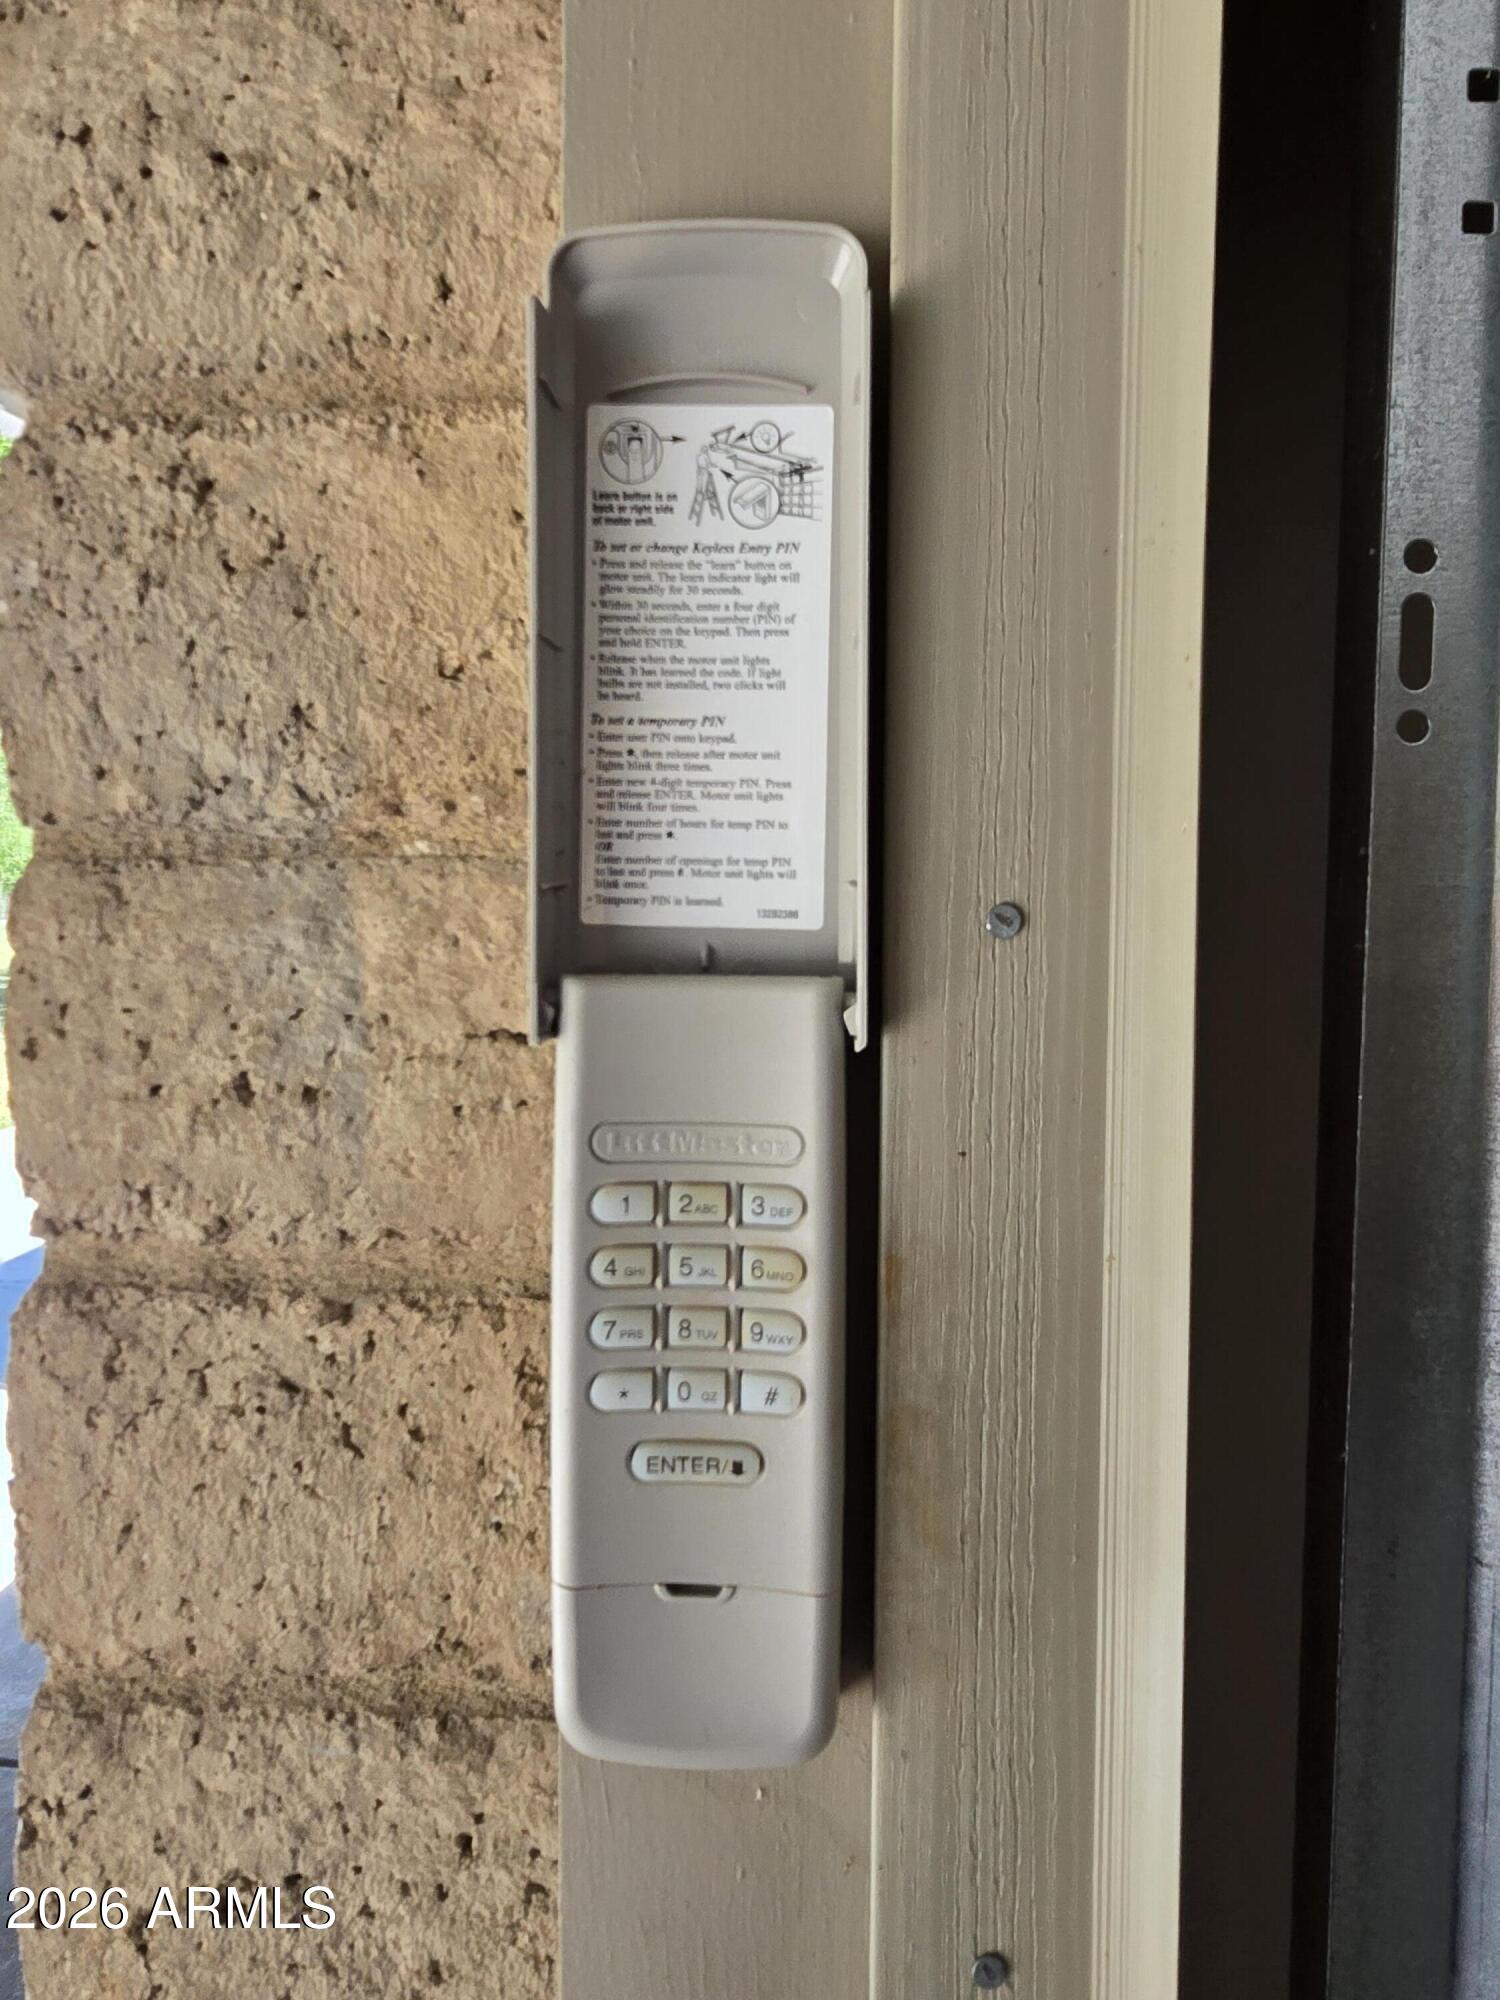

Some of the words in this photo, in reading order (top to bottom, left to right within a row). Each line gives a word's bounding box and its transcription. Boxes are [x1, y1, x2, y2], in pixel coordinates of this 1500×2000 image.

[593, 541, 606, 552] To
[610, 543, 626, 552] set
[646, 543, 687, 555] change
[692, 543, 734, 555] Keyless
[739, 543, 770, 555] Entry
[776, 543, 801, 553] PIN
[599, 560, 625, 569] Press
[629, 560, 646, 569] and
[650, 560, 684, 569] release
[687, 560, 702, 569] the
[744, 560, 775, 570] button
[658, 573, 676, 582] The
[680, 573, 704, 582] learn
[708, 573, 750, 582] indicator
[754, 573, 777, 585] light
[780, 573, 800, 582] will
[599, 586, 623, 596] glow
[627, 586, 665, 597] steadily
[669, 586, 683, 595] for
[686, 586, 699, 595] 30
[599, 601, 632, 610] Within
[637, 602, 648, 610] 30
[733, 603, 754, 611] four
[757, 602, 779, 614] digit
[598, 615, 641, 625] personal
[644, 614, 709, 623] identification
[712, 615, 749, 624] number
[785, 615, 796, 624] of
[598, 628, 621, 637] your
[624, 627, 656, 636] choice
[675, 627, 690, 636] the
[736, 627, 760, 637] Then
[763, 630, 789, 640] press
[598, 639, 617, 647] and
[620, 639, 642, 648] hold
[598, 655, 636, 664] Release
[640, 656, 666, 664] when
[670, 656, 684, 664] the
[720, 656, 739, 664] unit
[743, 656, 770, 668] lights
[641, 668, 657, 677] has
[660, 668, 696, 677] learned
[700, 668, 714, 677] the
[759, 669, 781, 680] light
[591, 714, 604, 725] To
[608, 716, 624, 725] set
[638, 718, 697, 728] temporary
[701, 716, 726, 727] PIN
[597, 733, 624, 742] Enter
[650, 733, 671, 742] PIN
[674, 735, 695, 743] onto
[597, 750, 623, 759] Press
[642, 751, 663, 759] then
[666, 751, 700, 759] release
[703, 751, 725, 760] after
[762, 752, 780, 760] unit
[597, 762, 624, 772] lights
[628, 762, 651, 770] blink
[656, 762, 680, 771] three
[597, 778, 624, 786] Enter
[686, 780, 734, 790] temporary
[765, 780, 791, 789] Press
[597, 790, 614, 799] and
[618, 790, 650, 799] release
[700, 791, 730, 800] Motor
[734, 792, 753, 800] unit
[756, 792, 783, 803] lights
[597, 802, 615, 811] will
[619, 802, 643, 811] blink
[647, 803, 667, 812] four
[598, 819, 622, 827] Enter
[627, 819, 663, 828] number
[667, 819, 678, 828] of
[681, 819, 707, 829] hours
[711, 820, 724, 829] for
[728, 821, 752, 831] temp
[756, 821, 775, 829] PIN
[596, 856, 621, 865] Enter
[625, 857, 662, 865] number
[666, 856, 677, 865] of
[679, 859, 723, 869] openings
[727, 858, 740, 867] for
[744, 859, 768, 869] temp
[772, 858, 791, 867] PIN
[596, 895, 646, 907] Temporary
[651, 896, 671, 905] PIN
[622, 1196, 629, 1214] 1
[679, 1195, 693, 1214] 2
[695, 1204, 718, 1214] ABC
[751, 1196, 765, 1216] 3
[770, 1207, 794, 1217] DEF
[604, 1258, 617, 1276] 4
[679, 1257, 693, 1276] 5
[698, 1267, 717, 1277] JKL
[751, 1259, 765, 1280] 6
[766, 1272, 794, 1280] MNO
[603, 1320, 616, 1340] 7
[620, 1329, 643, 1338] PRS
[678, 1319, 691, 1339] 8
[696, 1330, 718, 1339] TUV
[750, 1322, 764, 1343] 9
[766, 1334, 794, 1344] WXY
[677, 1381, 691, 1402] 0
